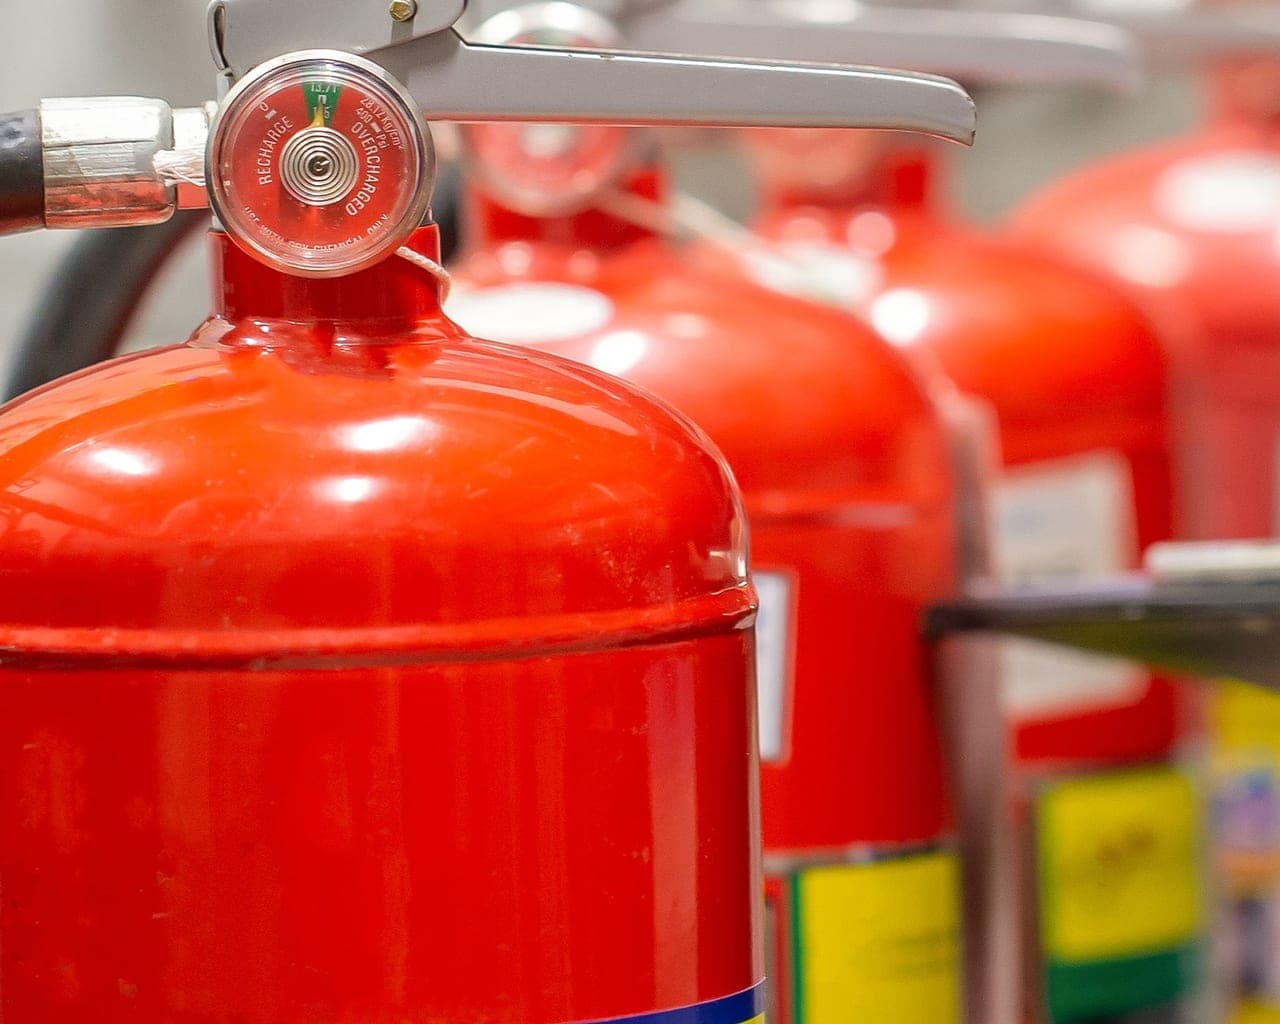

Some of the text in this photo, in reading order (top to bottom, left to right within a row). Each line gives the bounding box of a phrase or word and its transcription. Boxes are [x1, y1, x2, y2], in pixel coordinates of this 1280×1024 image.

[313, 106, 331, 119] 15
[356, 107, 373, 123] 400
[259, 116, 293, 185] RECHARGE
[346, 122, 381, 216] OVERCHARGED
